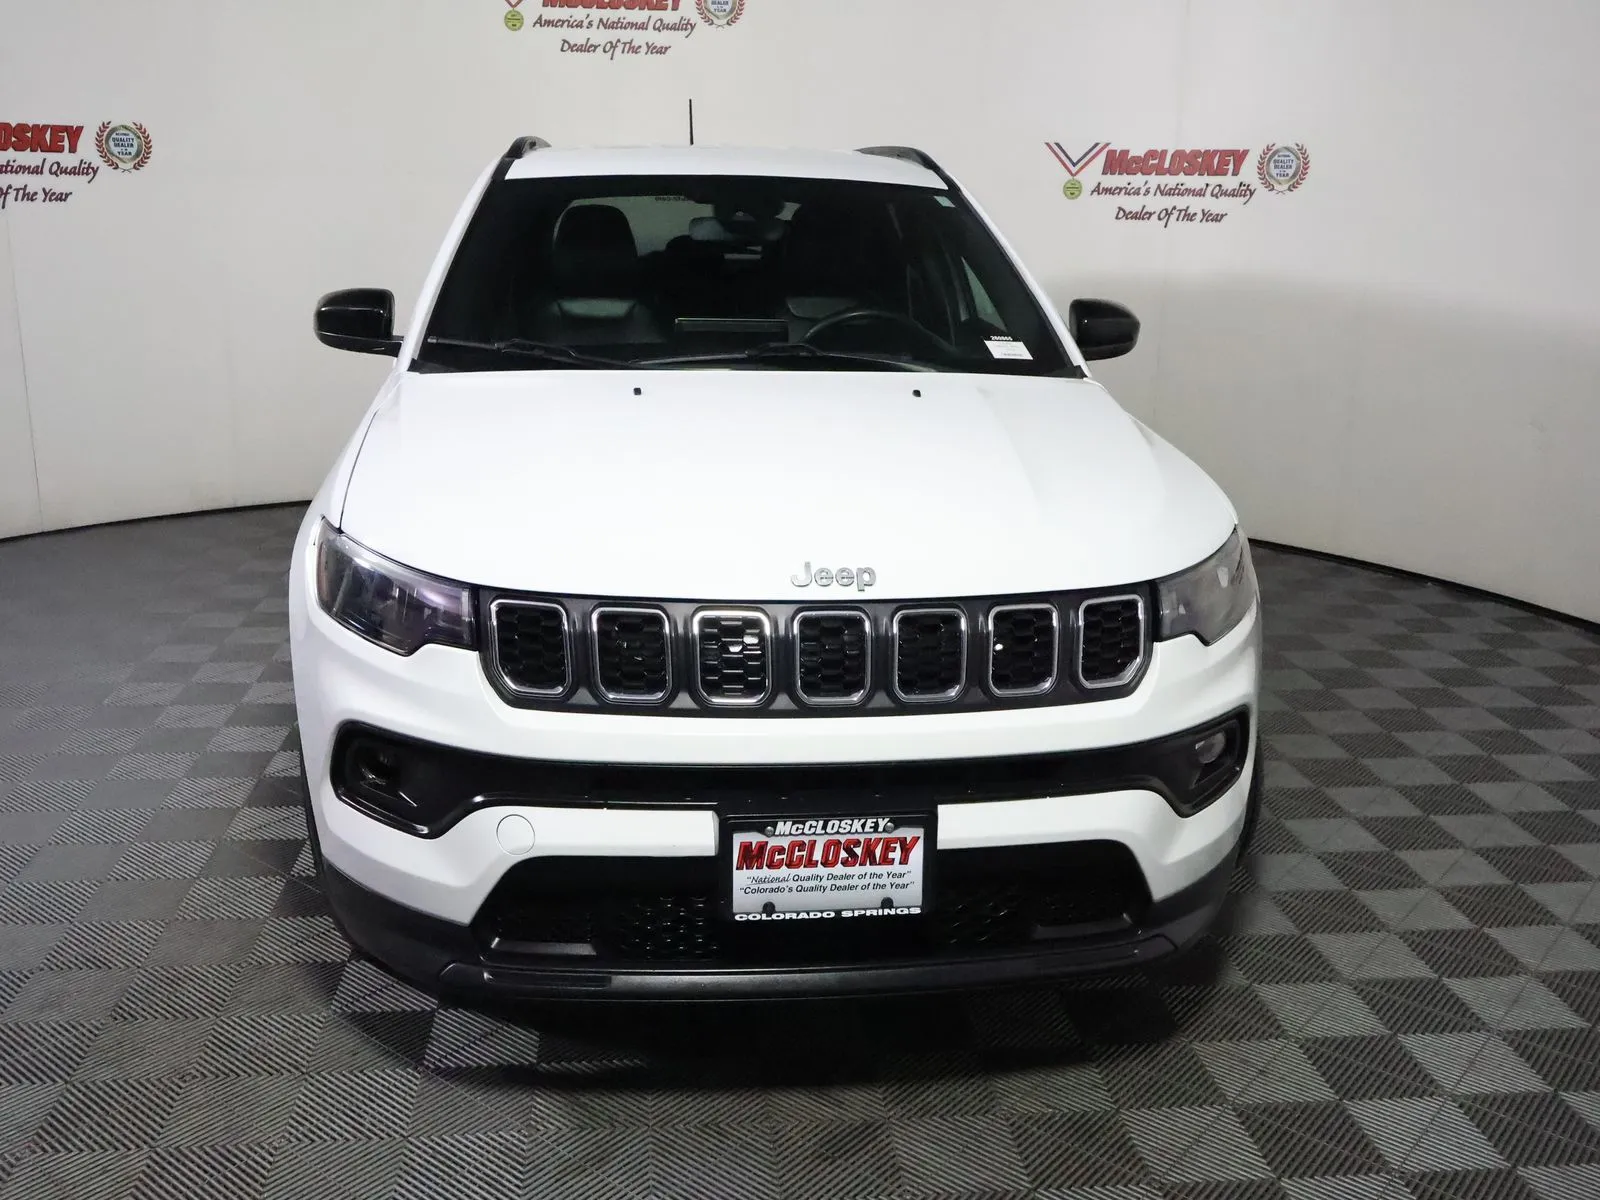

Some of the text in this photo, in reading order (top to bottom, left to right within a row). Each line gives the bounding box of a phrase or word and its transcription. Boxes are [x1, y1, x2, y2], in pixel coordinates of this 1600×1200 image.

[533, 14, 593, 29] America's
[597, 16, 652, 31] National
[653, 16, 697, 39] Quality
[560, 37, 672, 61] Dealer Of The Year
[48, 159, 99, 184] Quality
[1101, 149, 1250, 176] McCLOSKEY
[13, 184, 38, 202] The
[42, 187, 73, 203] Year
[1090, 180, 1150, 197] America's
[1153, 182, 1208, 198] National
[1209, 182, 1257, 206] Quality
[1115, 204, 1228, 228] Dealer Of The Year
[791, 561, 876, 592] Jeep
[775, 818, 890, 836] McCLOSKEY
[736, 836, 921, 870] McCLOSKEY
[792, 873, 825, 883] Quality
[826, 872, 855, 881] Dealer
[857, 871, 869, 880] of
[869, 871, 885, 880] the
[795, 884, 828, 895] Quality
[829, 883, 859, 891] Dealer
[860, 882, 873, 891] of
[873, 882, 888, 890] the
[734, 907, 921, 921] COLORADO SPRINGS
